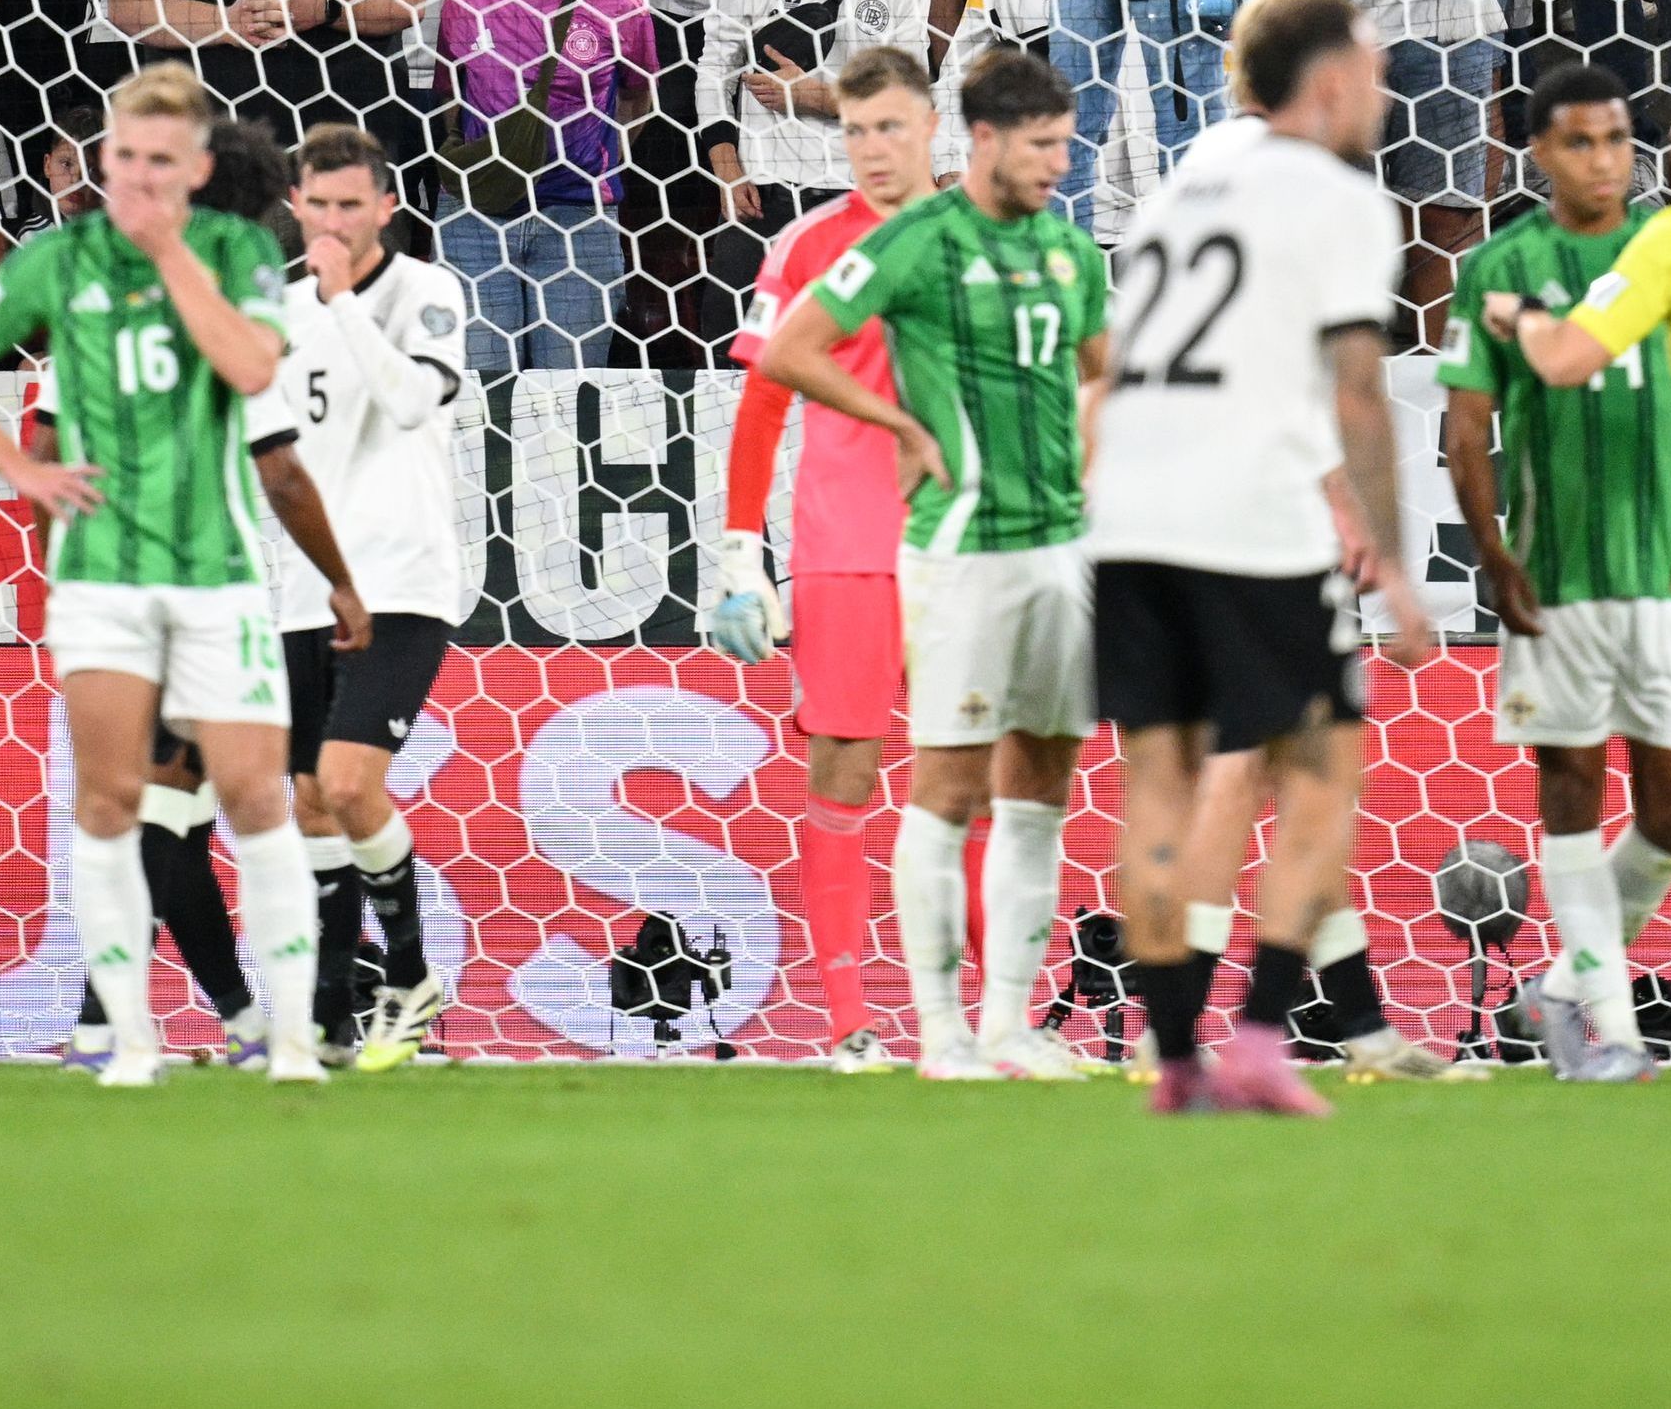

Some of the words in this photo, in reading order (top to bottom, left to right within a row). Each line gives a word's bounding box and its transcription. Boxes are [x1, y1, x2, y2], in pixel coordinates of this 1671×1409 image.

[1014, 303, 1061, 368] 17
[1108, 232, 1248, 386] 22
[115, 325, 180, 396] 16
[308, 370, 329, 425] 5
